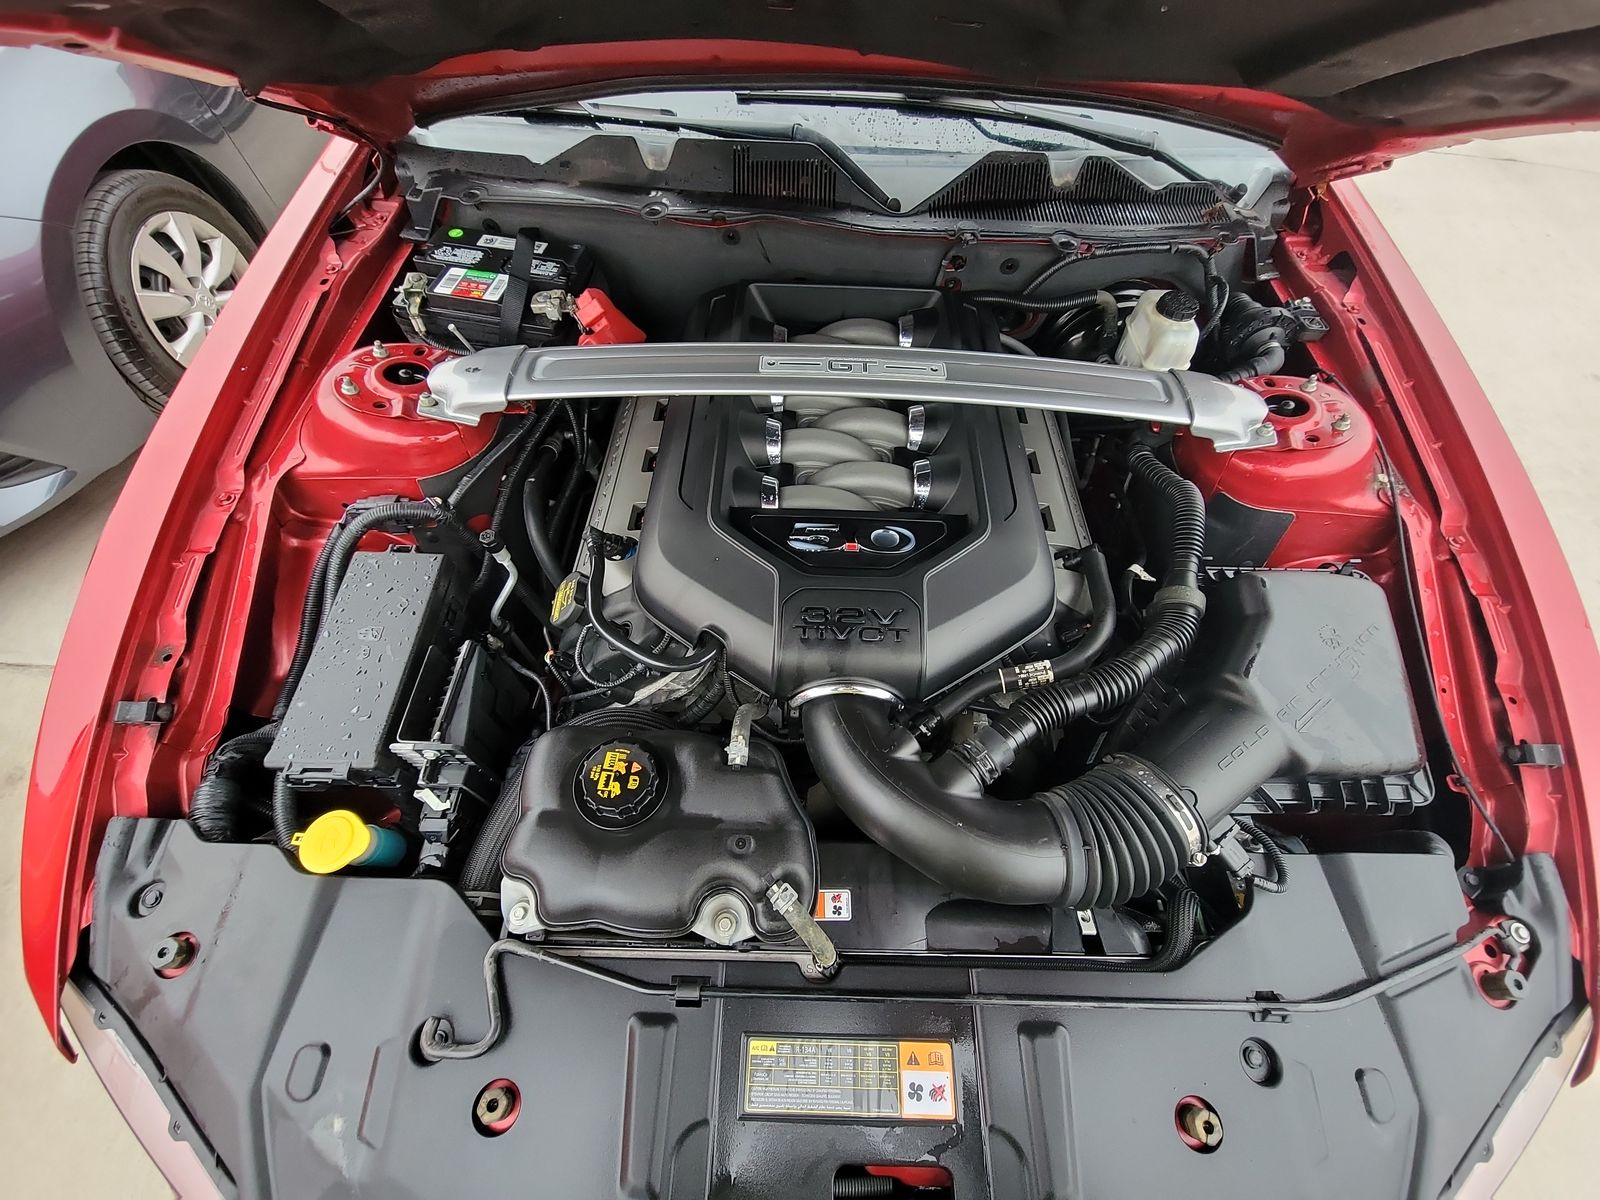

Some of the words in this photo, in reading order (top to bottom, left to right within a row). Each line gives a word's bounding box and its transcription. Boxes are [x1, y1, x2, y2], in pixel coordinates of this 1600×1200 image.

[827, 357, 879, 374] GT
[787, 522, 917, 554] 5.0
[800, 605, 904, 625] 32V
[1217, 723, 1270, 771] COLD
